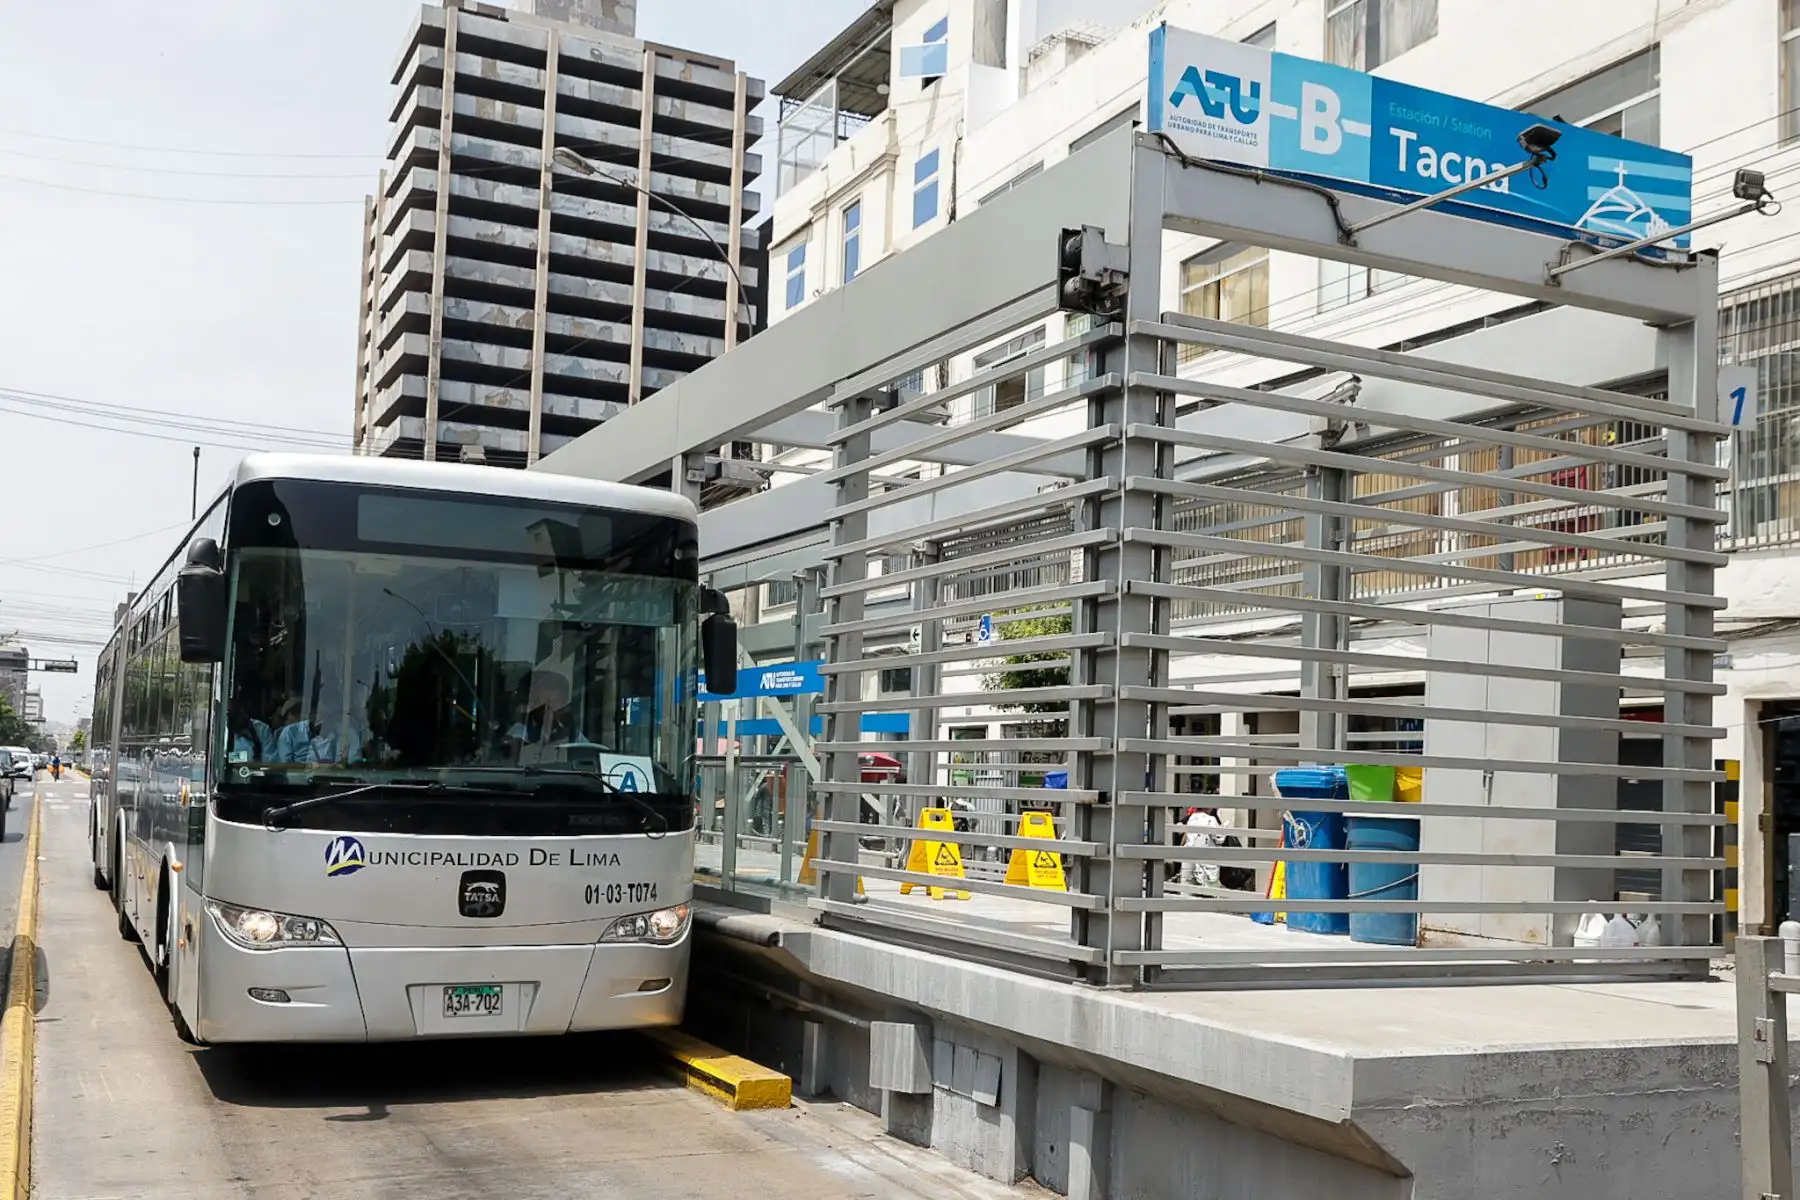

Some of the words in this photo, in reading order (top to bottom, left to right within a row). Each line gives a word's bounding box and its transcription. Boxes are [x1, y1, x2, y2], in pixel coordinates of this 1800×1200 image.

[1169, 65, 1261, 125] ATU
[1169, 114, 1207, 128] AUTORIDAD
[1207, 121, 1216, 130] DE
[1216, 123, 1258, 140] TRANSPORTE
[1301, 80, 1342, 155] B
[1389, 102, 1440, 128] Estación
[1451, 120, 1493, 142] Station
[1167, 121, 1195, 133] URBANO
[1195, 127, 1212, 137] PARA
[1212, 132, 1229, 141] LIMA
[1234, 136, 1259, 147] CALLAO
[1389, 127, 1510, 194] Tacna
[1729, 386, 1747, 426] 1
[618, 771, 638, 793] A
[464, 892, 501, 903] TATSA
[584, 881, 658, 905] 01-03-T074
[446, 993, 500, 1012] A3A-702
